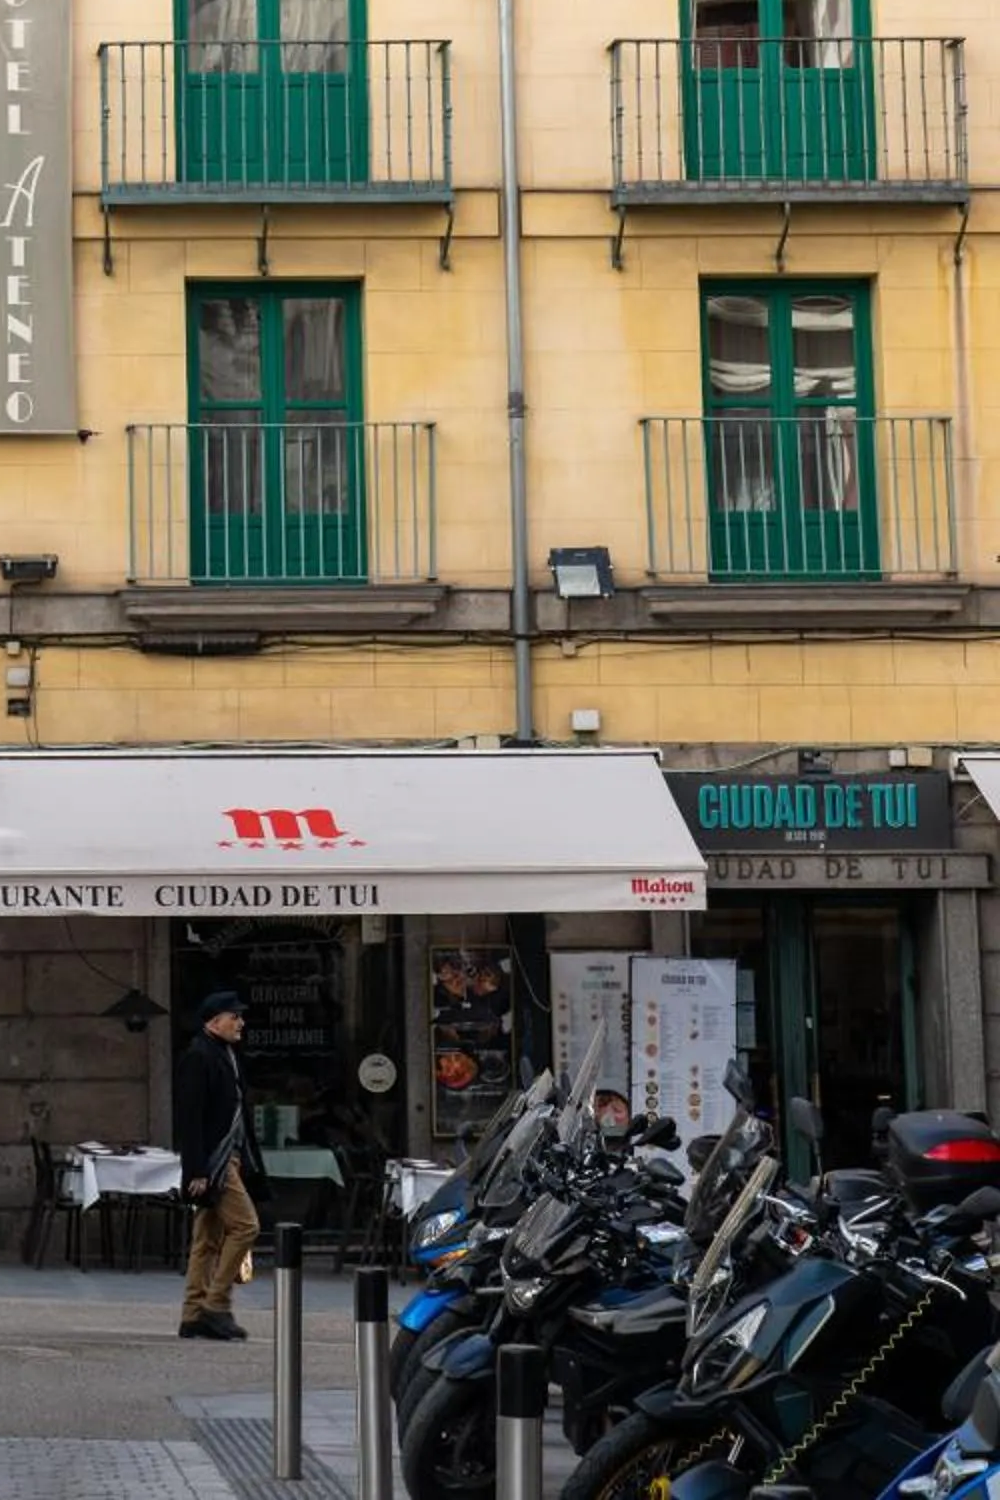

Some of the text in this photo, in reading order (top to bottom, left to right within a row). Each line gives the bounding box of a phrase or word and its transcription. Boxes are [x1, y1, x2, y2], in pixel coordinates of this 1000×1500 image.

[698, 783, 918, 829] CIUDAD DE TUI
[714, 857, 949, 880] UDAD DE TUI
[154, 885, 272, 907] CIUDAD
[281, 885, 321, 907] DE
[328, 884, 380, 907] TUI
[631, 878, 695, 895] Mahou
